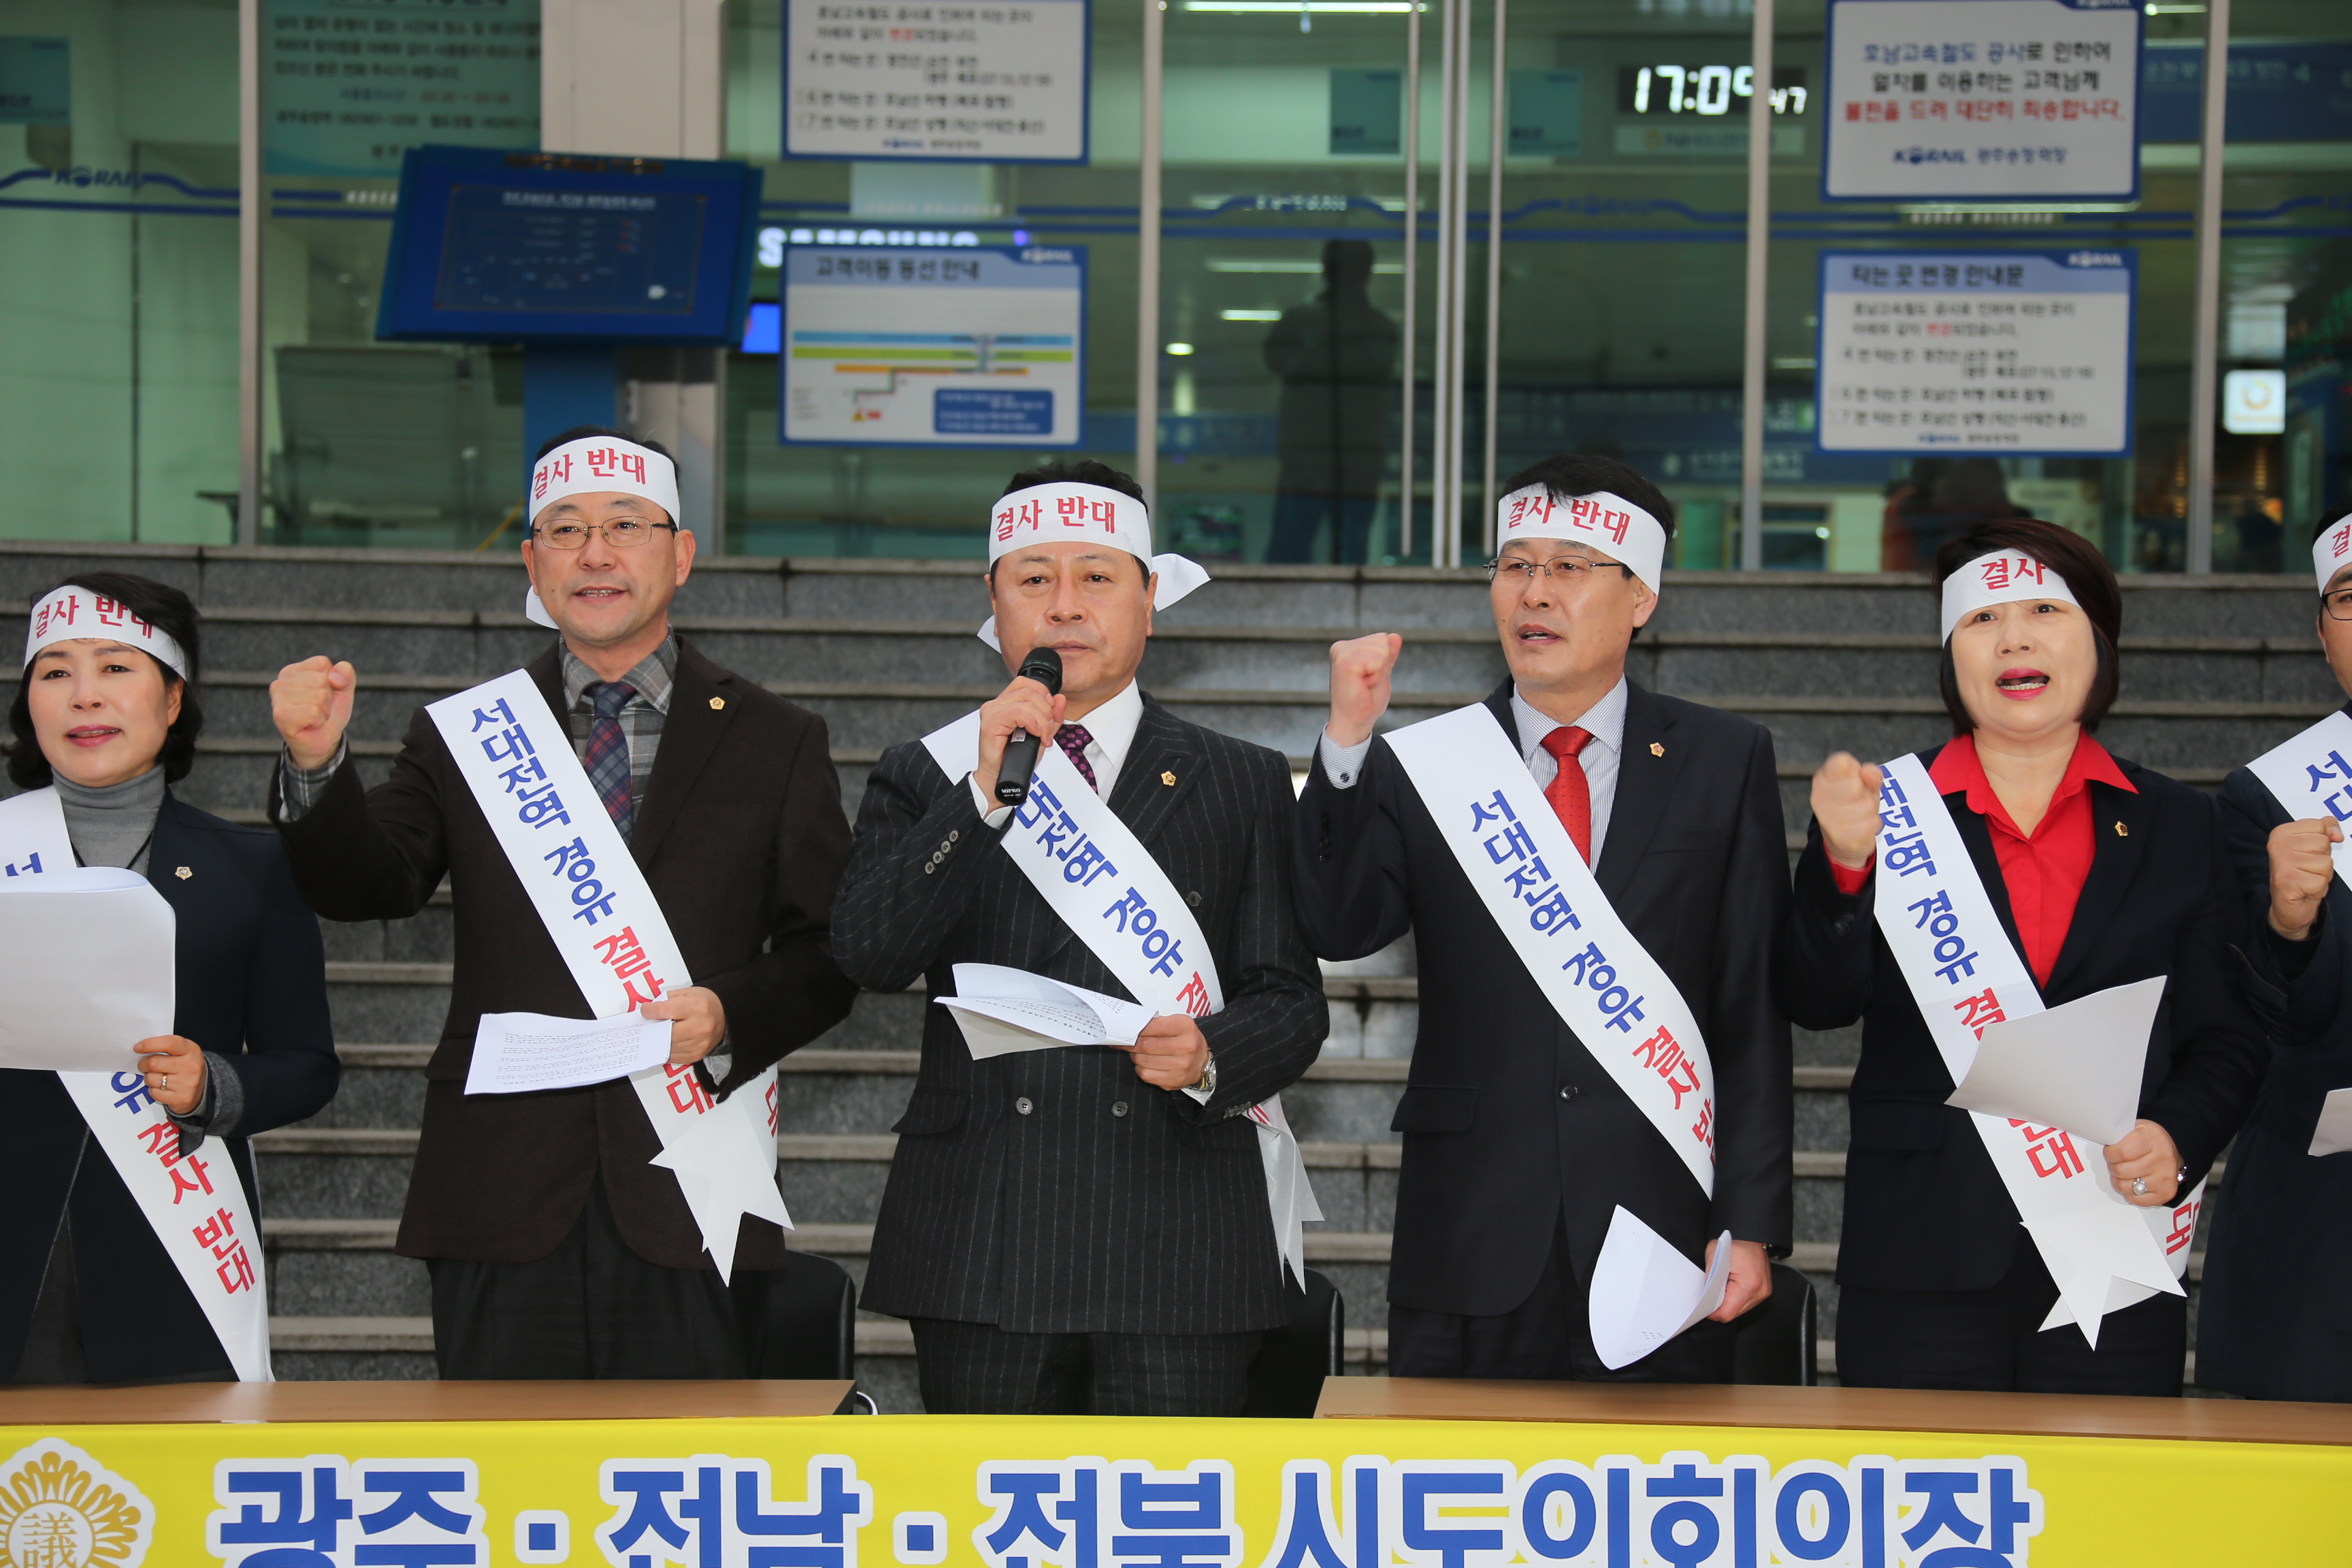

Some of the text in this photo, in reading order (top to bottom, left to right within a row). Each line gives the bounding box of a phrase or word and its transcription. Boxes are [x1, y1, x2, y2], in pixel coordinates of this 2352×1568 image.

[1863, 41, 2112, 65] 호남고속철도 공사로 인하여
[1873, 71, 2100, 93] 열차를 이용하는 고객님께
[1845, 100, 1900, 122] 불편을
[1910, 101, 1948, 121] 드려
[1956, 101, 2015, 121] 대단히
[1893, 147, 1966, 165] KORAIL
[1852, 265, 1890, 287] 타는
[534, 447, 645, 500] 결사 반대
[996, 496, 1115, 542] 결사 반대
[1508, 493, 1631, 545] 결사 반대
[1981, 558, 2046, 590] 결사
[35, 595, 79, 639] 결사
[471, 698, 571, 830] 서대전역
[544, 836, 616, 926] 경유
[1015, 772, 1118, 887] 대전역
[1102, 886, 1183, 978] 경유
[1470, 789, 1582, 936] 서대전역
[1562, 941, 1646, 1033] 경유
[1633, 1025, 1701, 1110] 결사
[1908, 889, 1979, 985] 경유
[193, 1207, 255, 1294] 반대
